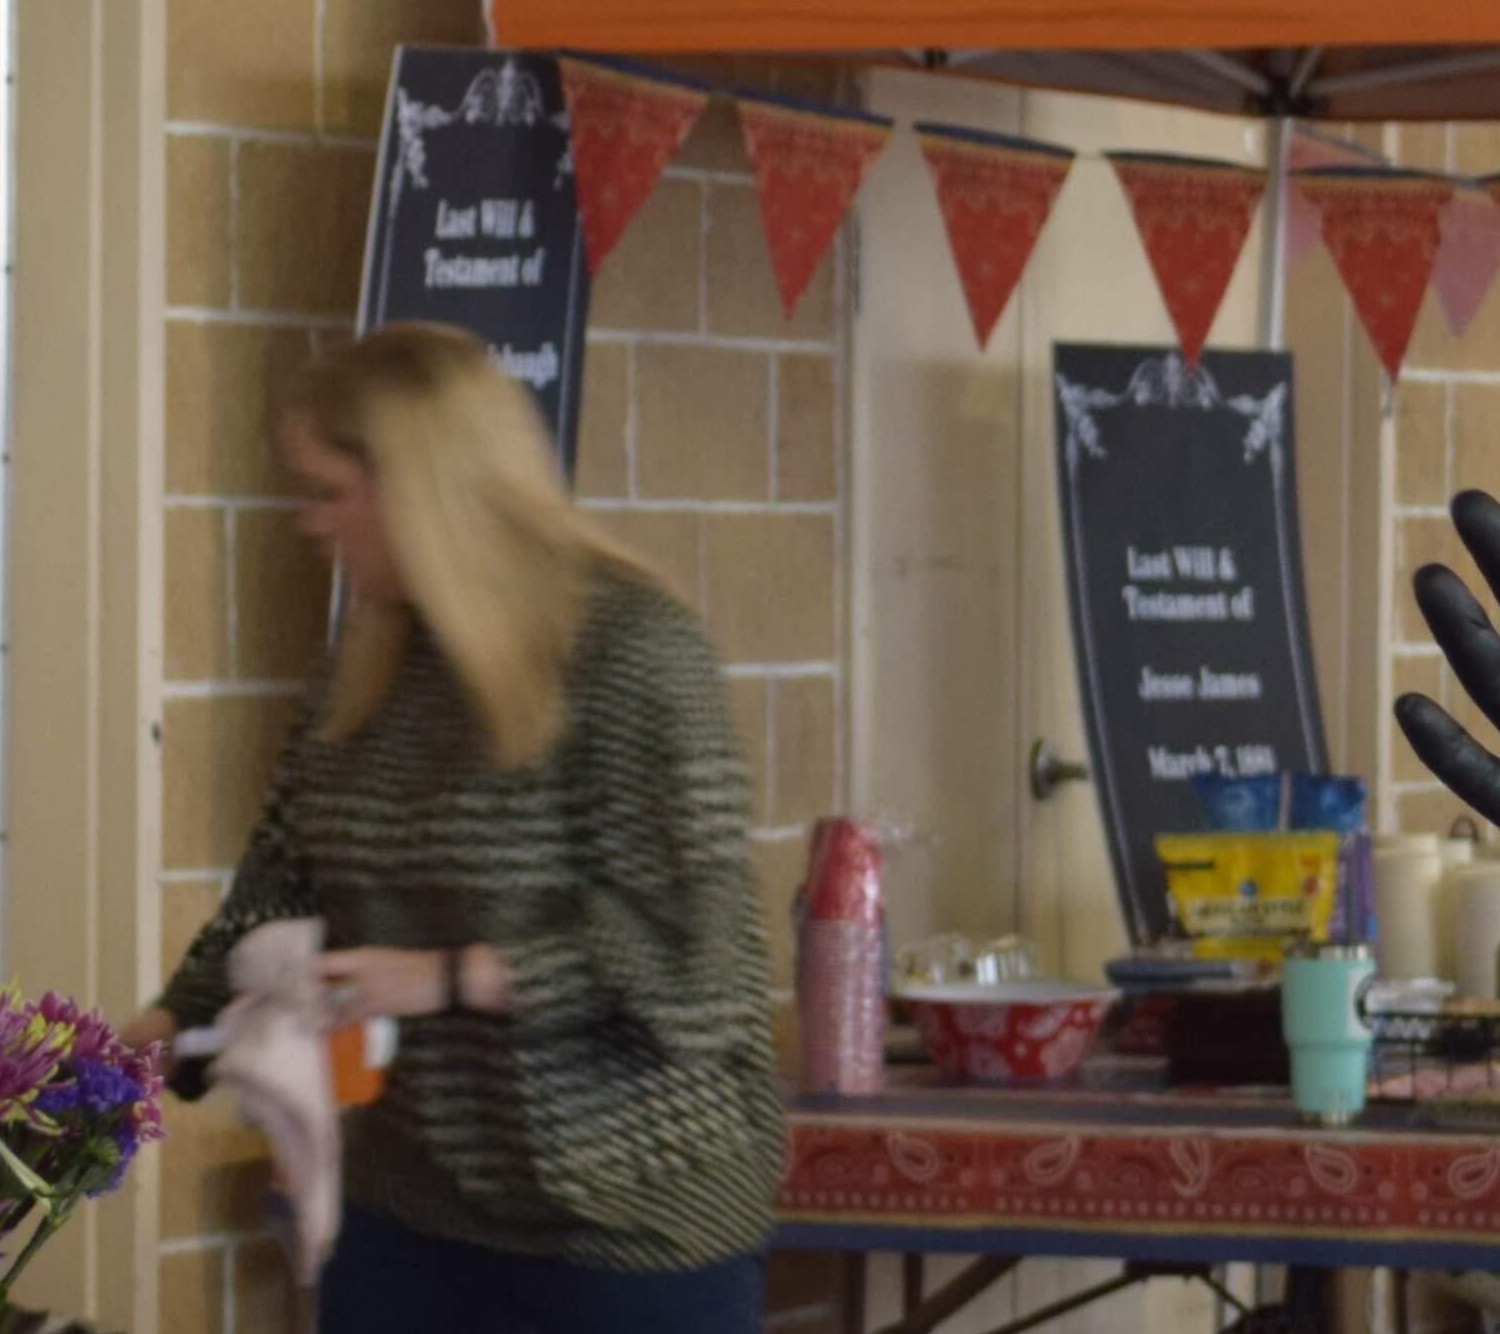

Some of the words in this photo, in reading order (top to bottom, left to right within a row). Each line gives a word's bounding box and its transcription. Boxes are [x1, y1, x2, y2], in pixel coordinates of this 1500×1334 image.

[435, 198, 477, 239] Last
[480, 198, 519, 238] Will
[424, 247, 520, 288] Testament
[521, 247, 545, 287] of
[1127, 546, 1172, 580] Last
[1173, 546, 1216, 581] Will
[1218, 546, 1237, 581] &
[1122, 585, 1229, 621] Testament
[1230, 585, 1255, 621] of
[1138, 666, 1196, 701] Jesse
[1197, 666, 1263, 700] James
[1147, 745, 1213, 780] March
